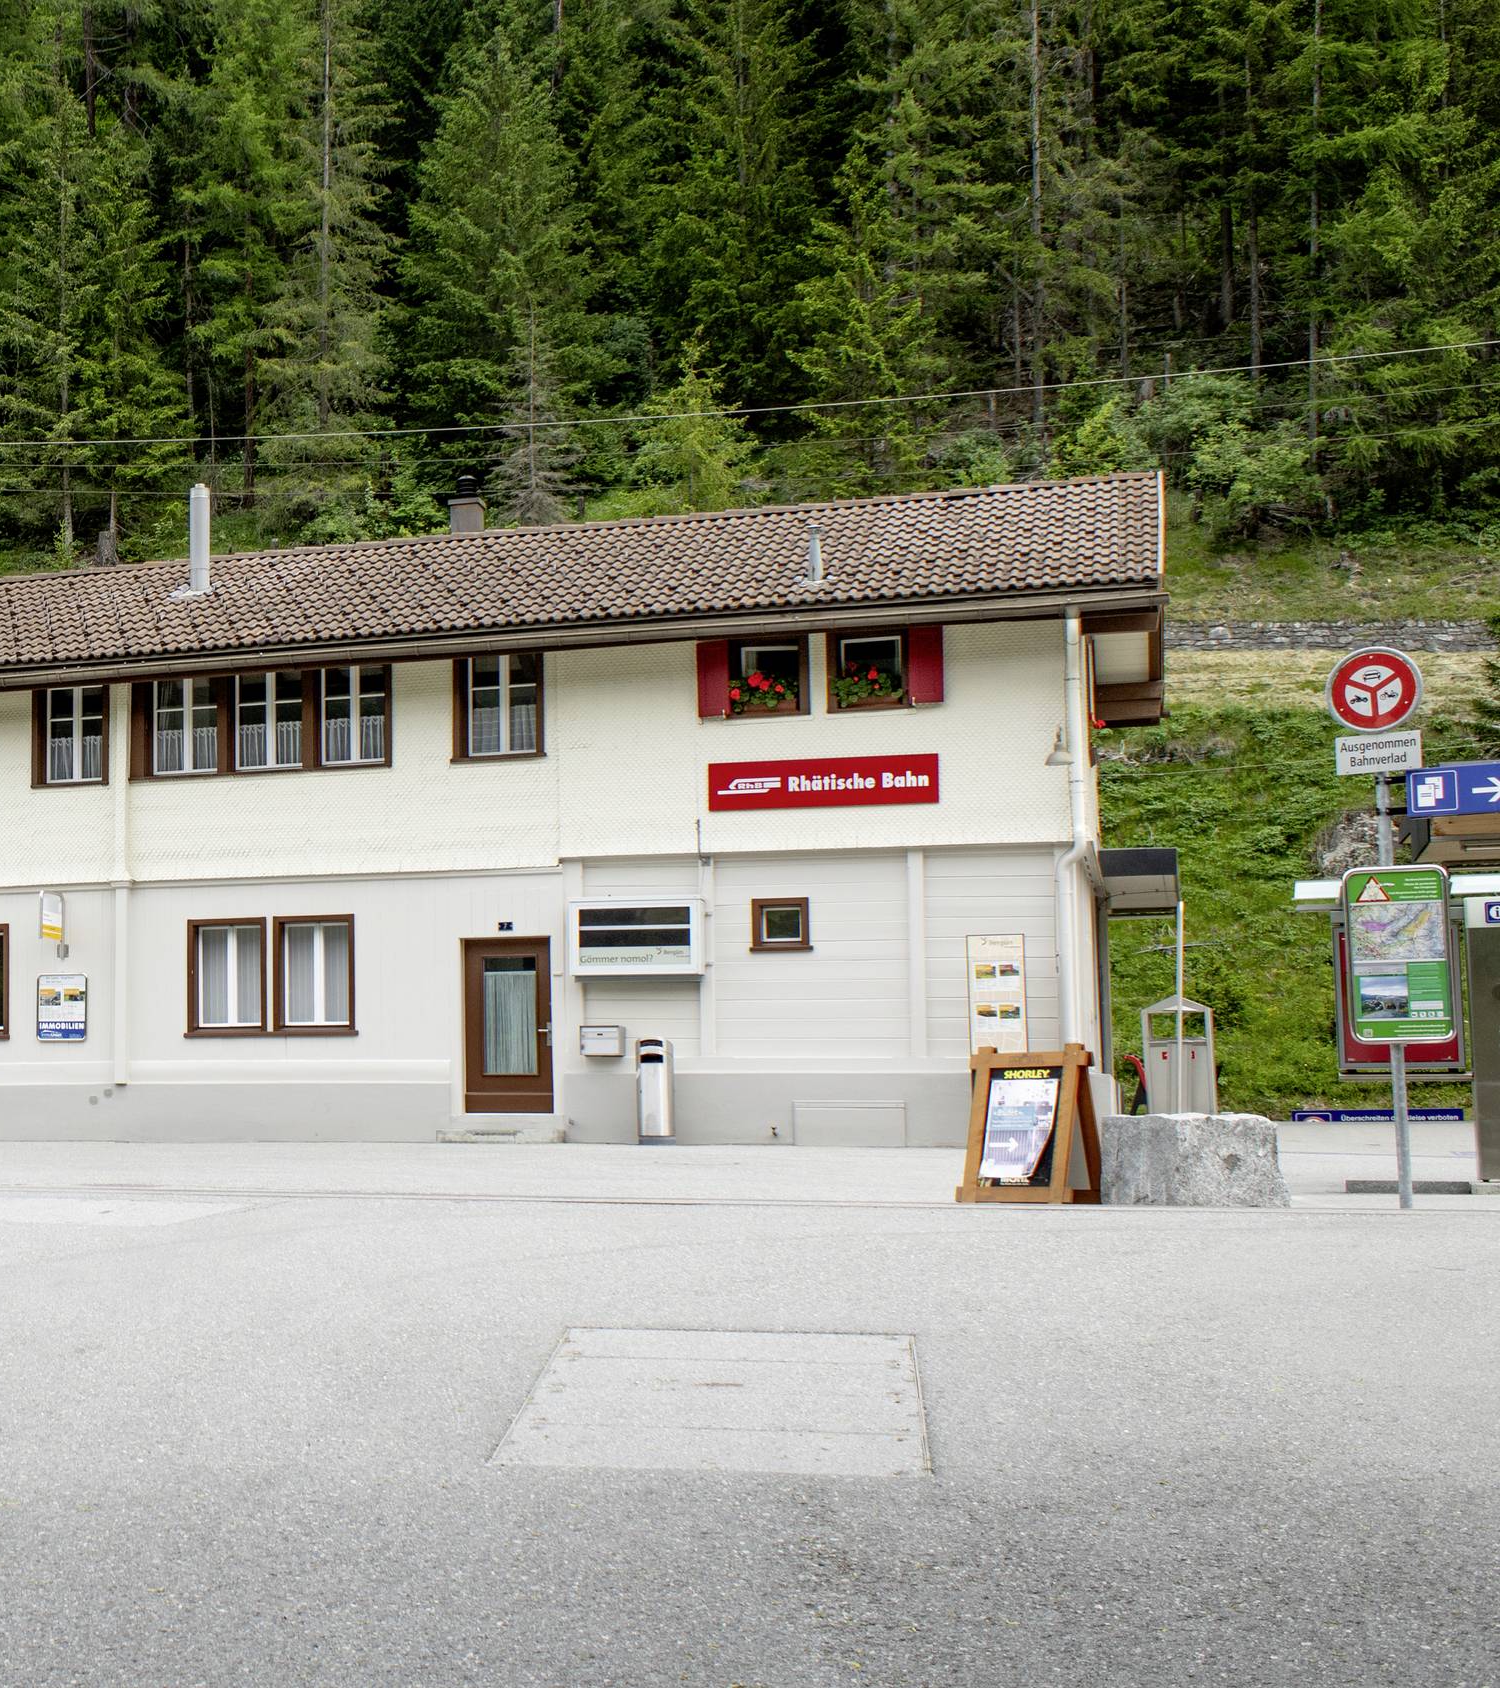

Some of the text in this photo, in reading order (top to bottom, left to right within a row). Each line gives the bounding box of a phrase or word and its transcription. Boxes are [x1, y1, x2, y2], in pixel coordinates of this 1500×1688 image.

[1340, 738, 1417, 754] Ausgenommen
[1350, 752, 1407, 767] Bahnverlad
[787, 773, 876, 792] Rhätische
[881, 770, 929, 788] Bahn
[39, 1022, 85, 1030] IMMOBILIEN
[1003, 1069, 1050, 1079] SHORLEY
[1340, 1113, 1389, 1122] Überschreiten
